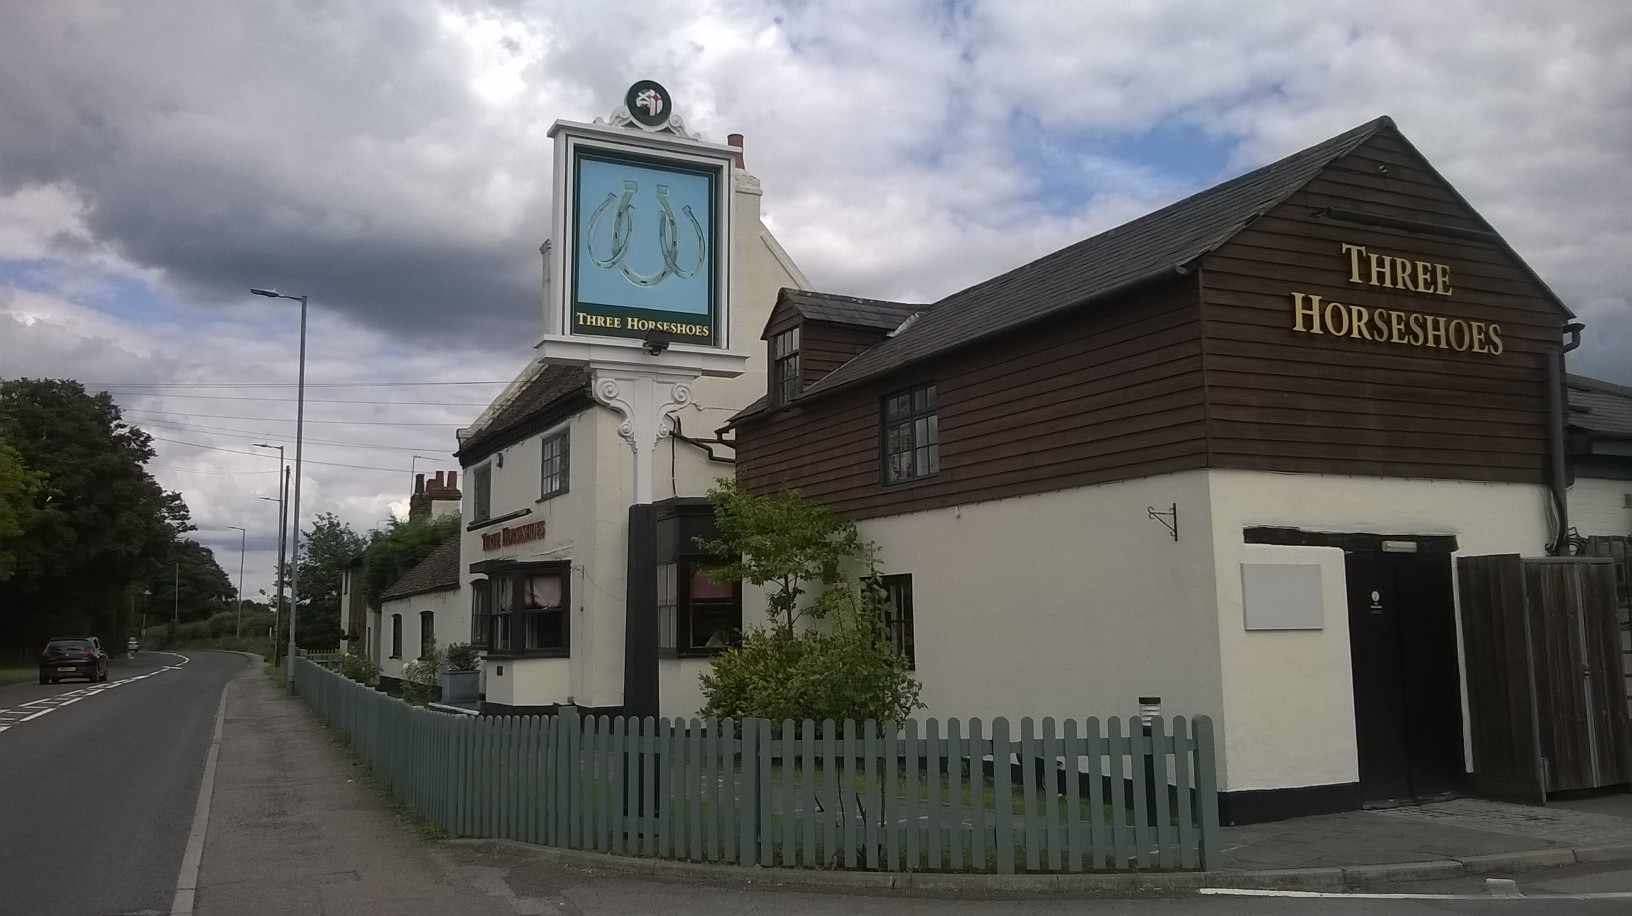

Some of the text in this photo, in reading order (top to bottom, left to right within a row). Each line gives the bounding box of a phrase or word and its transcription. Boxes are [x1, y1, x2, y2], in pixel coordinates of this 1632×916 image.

[1342, 243, 1453, 295] THREE
[576, 312, 621, 329] THREE
[1291, 292, 1503, 356] HORSESHOES
